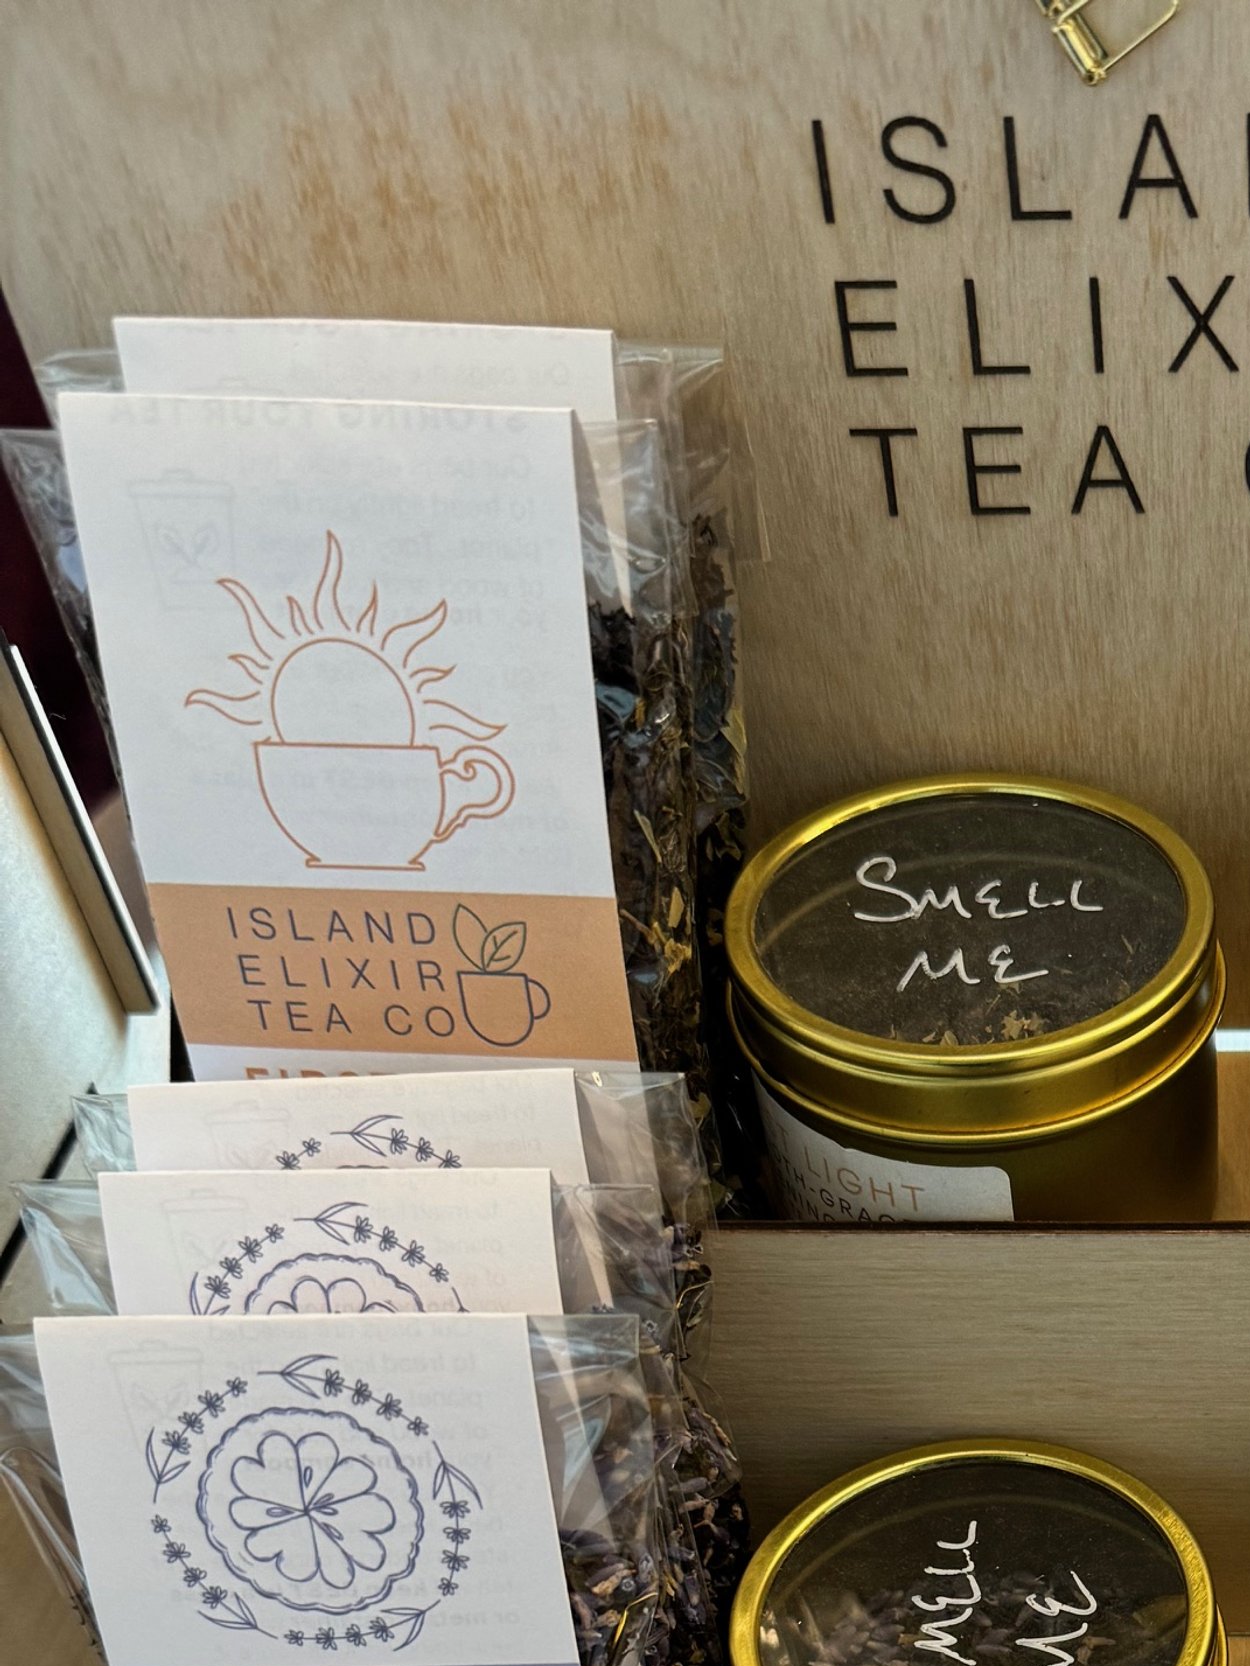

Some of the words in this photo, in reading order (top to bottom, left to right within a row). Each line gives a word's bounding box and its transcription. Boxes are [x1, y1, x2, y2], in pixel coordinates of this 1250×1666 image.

[849, 424, 1145, 516] TEA
[226, 906, 436, 946] ISLAND
[240, 954, 446, 992] ELIXIR
[896, 945, 1049, 993] ME
[248, 1000, 352, 1033] TEA
[384, 1006, 455, 1036] CO
[804, 1147, 925, 1211] LIGHT
